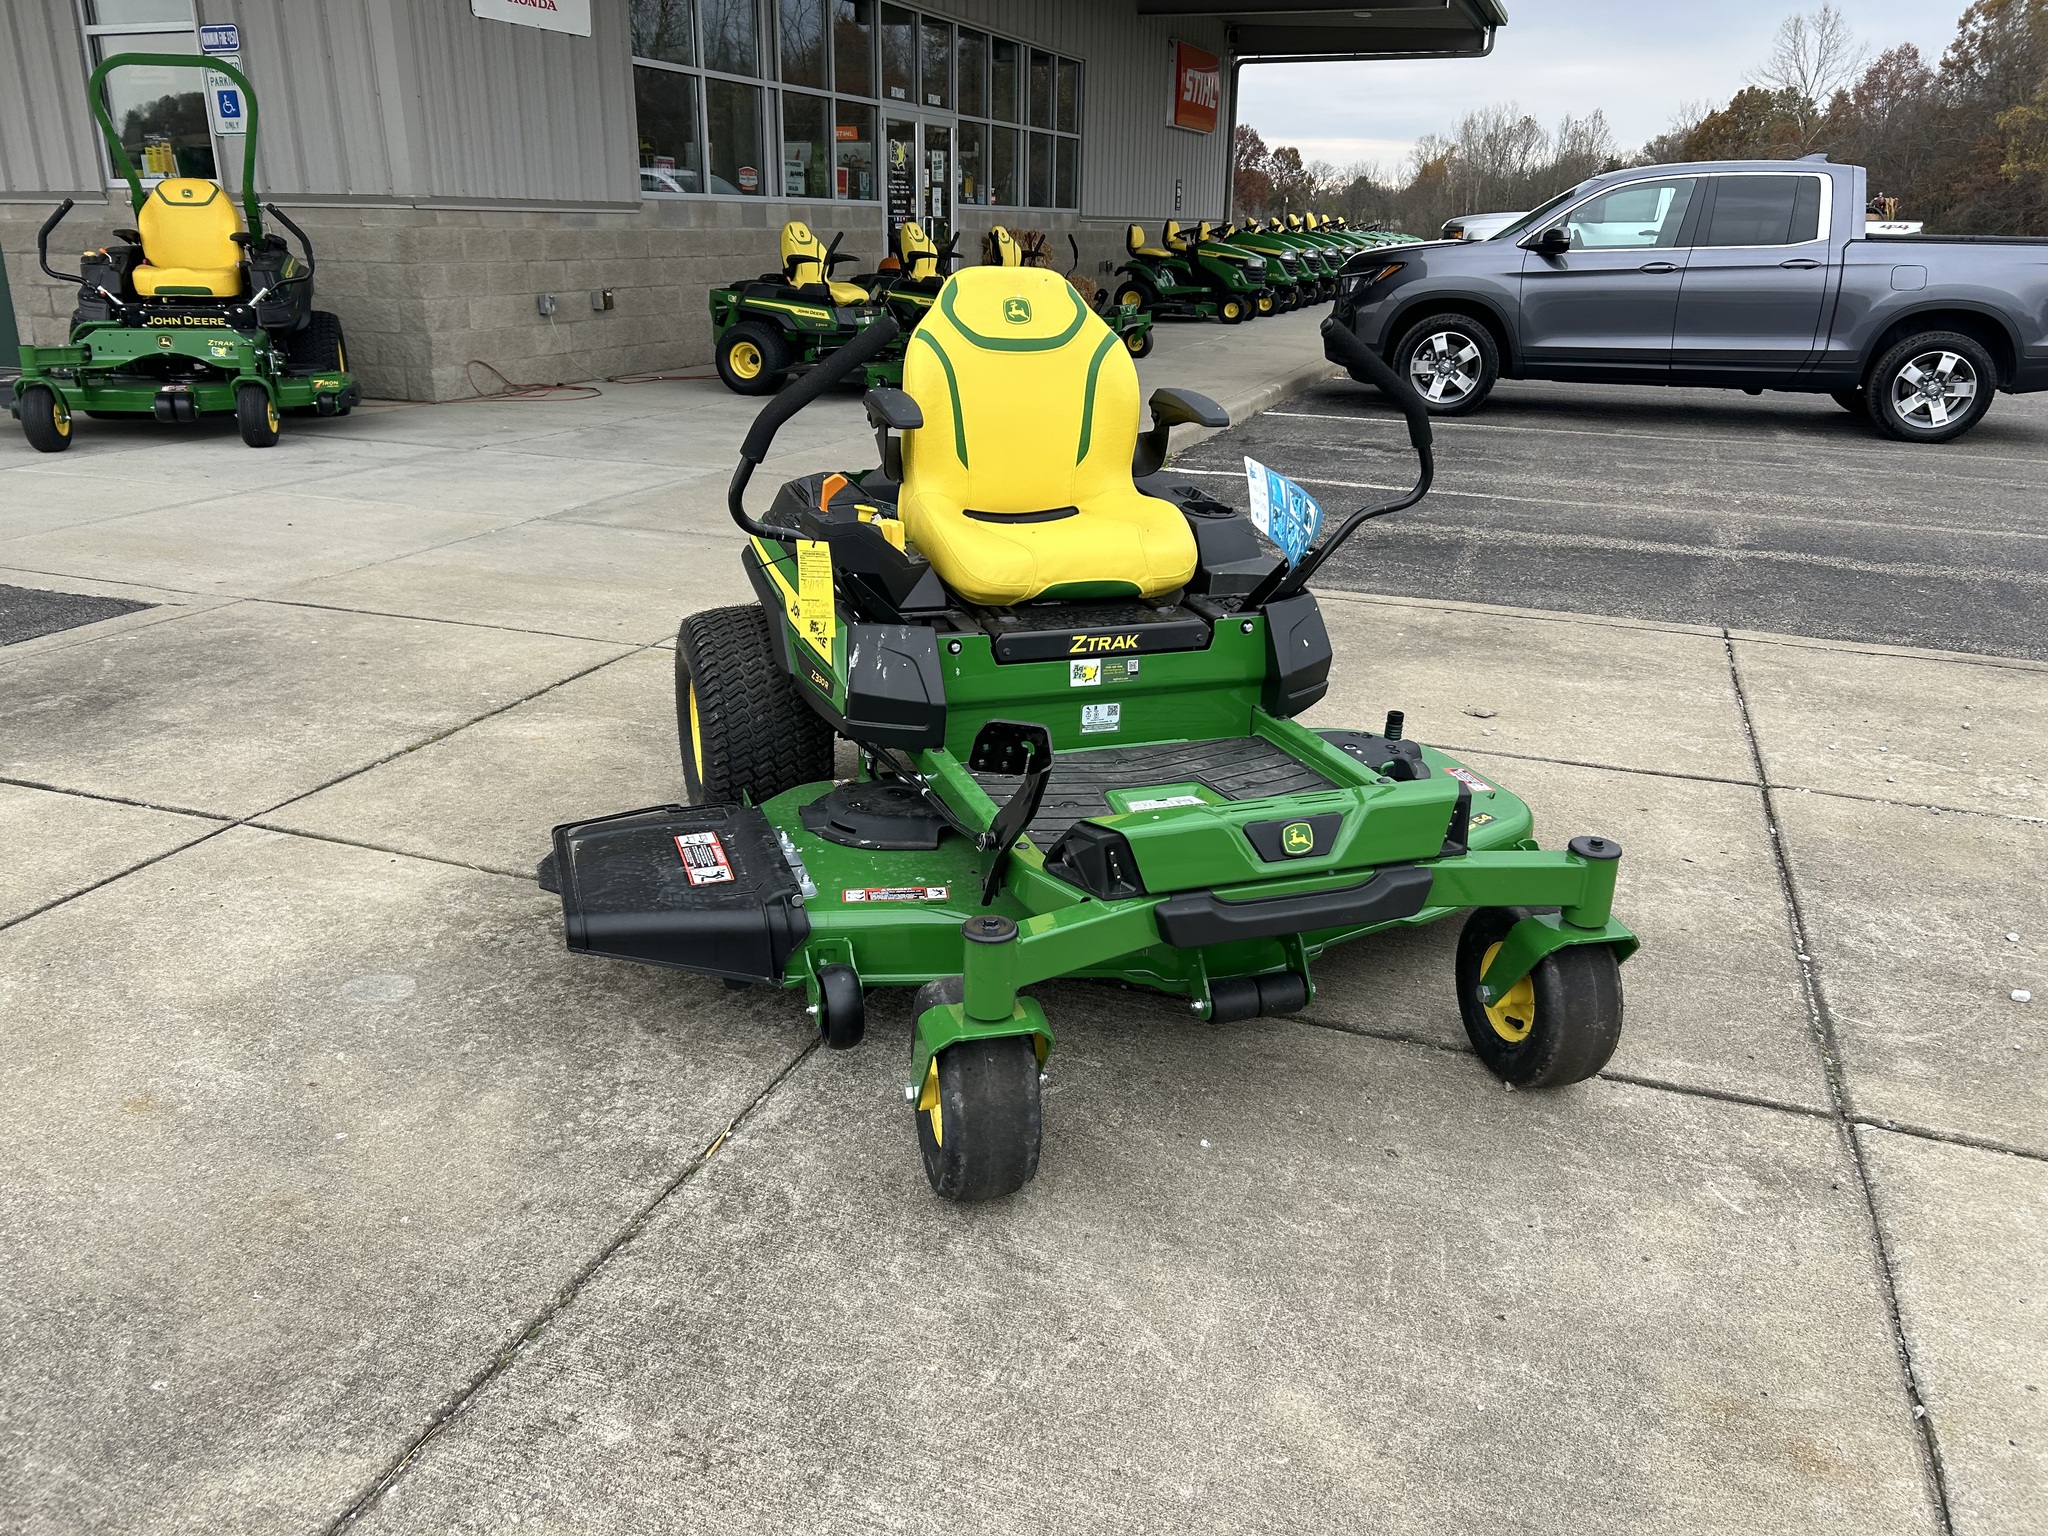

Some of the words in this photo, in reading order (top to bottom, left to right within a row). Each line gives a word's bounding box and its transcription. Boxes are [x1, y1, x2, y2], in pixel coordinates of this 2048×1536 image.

[507, 0, 558, 11] ONDA
[210, 76, 237, 87] PARKIN
[1183, 68, 1217, 109] STIHL
[224, 121, 240, 130] ONLY
[147, 315, 181, 326] JOHN
[183, 315, 225, 326] DEERE
[207, 339, 235, 347] ZTRAK
[1069, 634, 1140, 654] ZTRAK
[1072, 671, 1087, 680] Pro
[1471, 813, 1493, 824] 54
